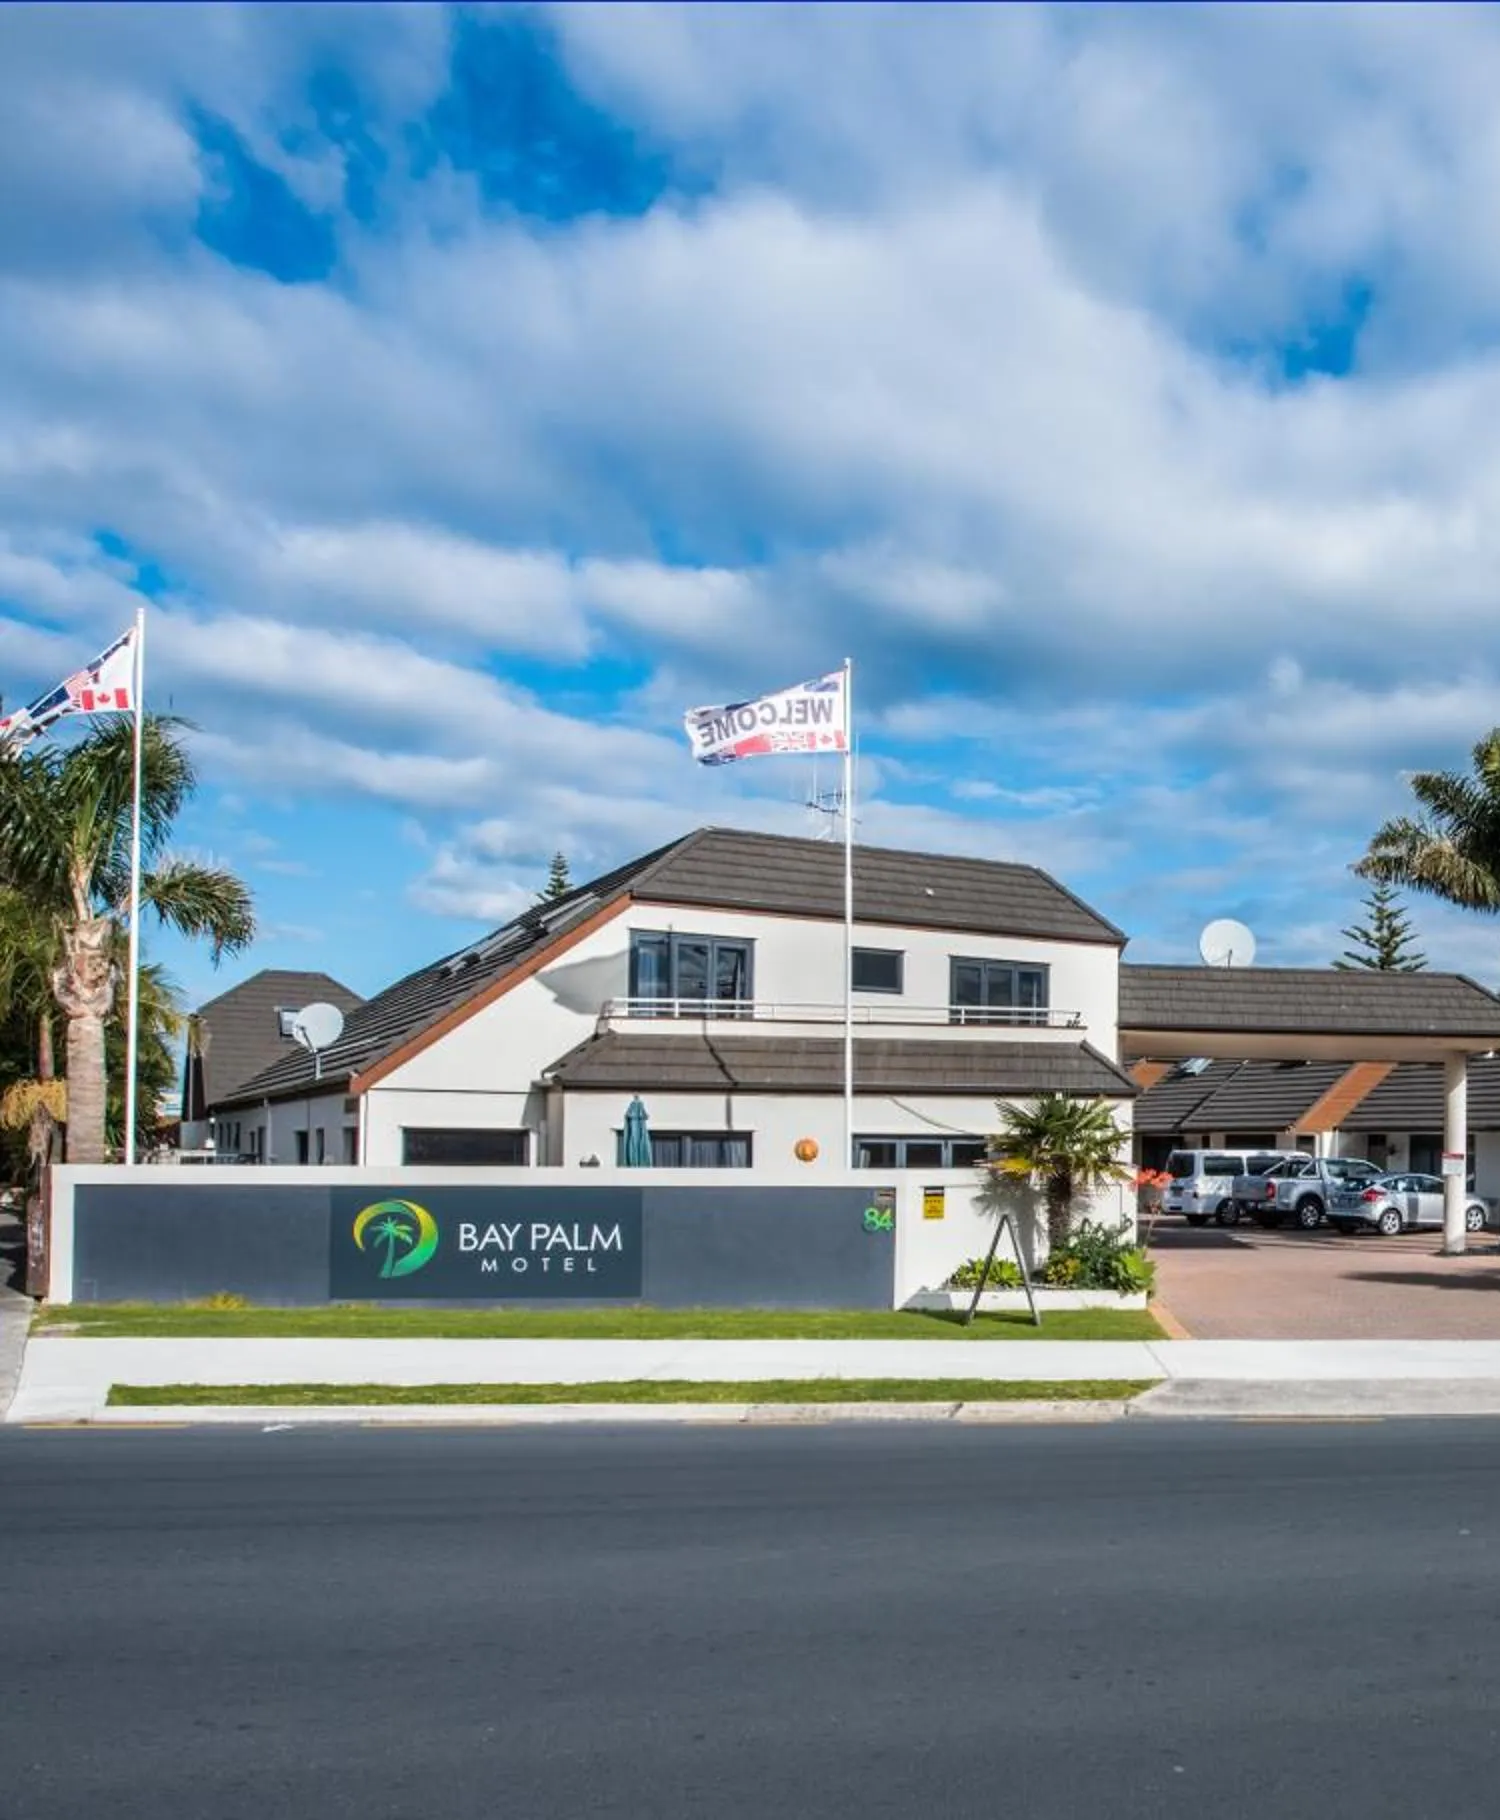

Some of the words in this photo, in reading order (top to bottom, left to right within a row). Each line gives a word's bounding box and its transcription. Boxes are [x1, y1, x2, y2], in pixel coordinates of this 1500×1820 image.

[863, 1207, 894, 1232] 84
[459, 1223, 522, 1251] BAY
[531, 1223, 623, 1251] PALM
[481, 1257, 597, 1273] MOTEL
